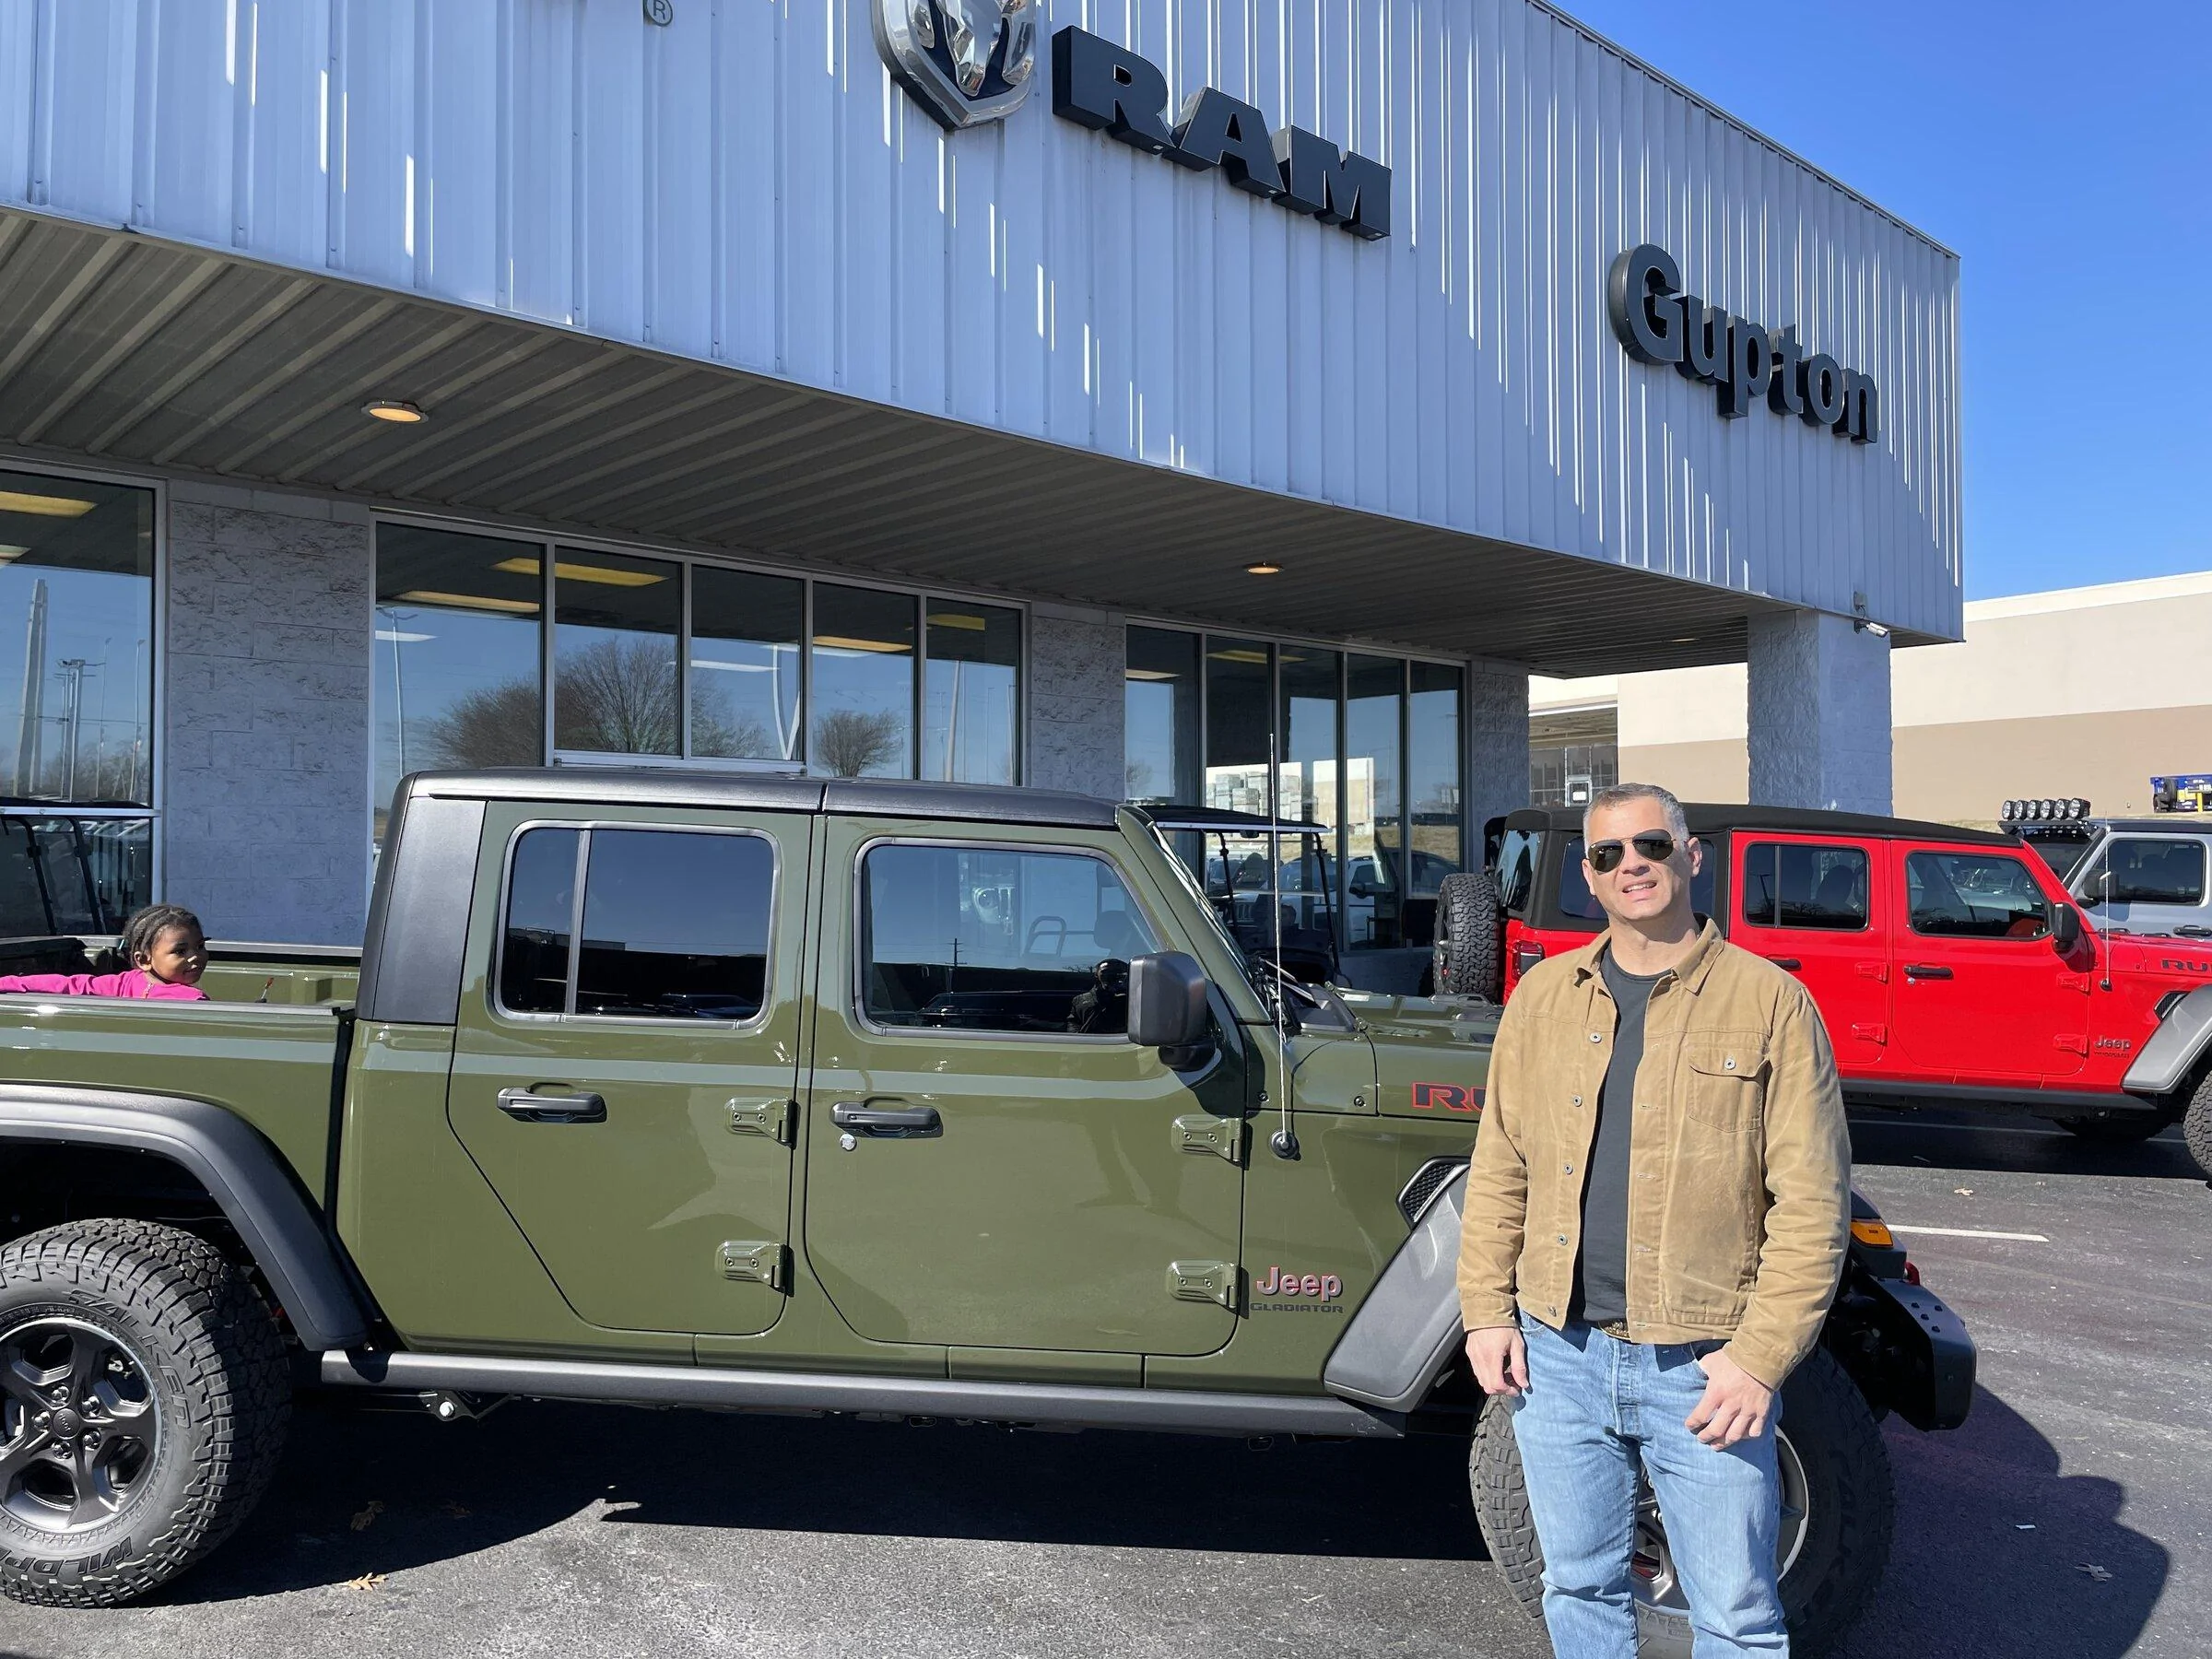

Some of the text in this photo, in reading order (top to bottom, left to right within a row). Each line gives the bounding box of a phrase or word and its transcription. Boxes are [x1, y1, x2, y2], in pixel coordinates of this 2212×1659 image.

[1052, 25, 1393, 241] RAM
[1609, 243, 1878, 444] Gupton
[2094, 1034, 2131, 1052] Jeep
[1256, 1266, 1343, 1302] Jeep
[1250, 1302, 1344, 1313] GLADIATOR
